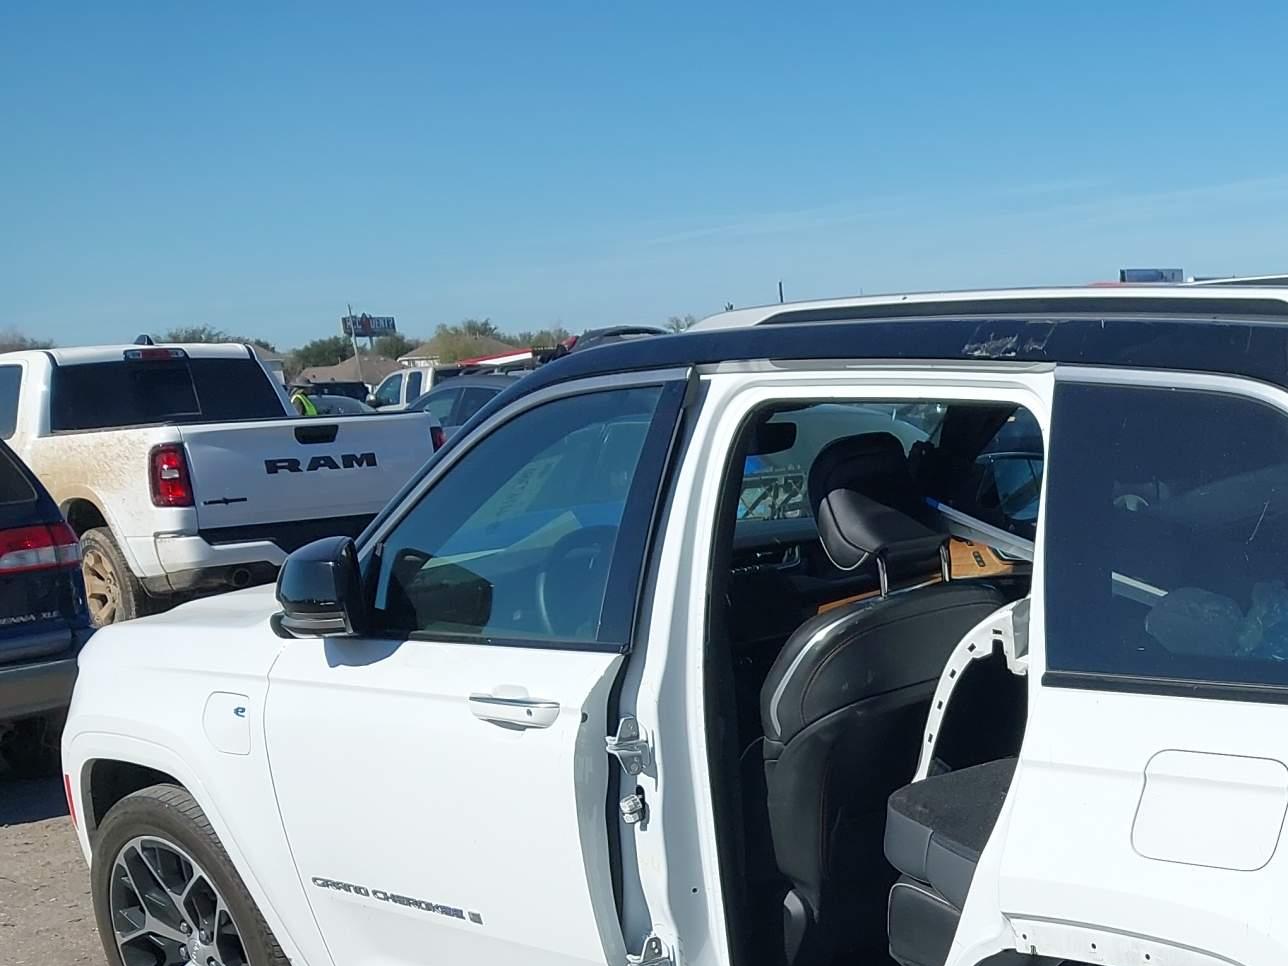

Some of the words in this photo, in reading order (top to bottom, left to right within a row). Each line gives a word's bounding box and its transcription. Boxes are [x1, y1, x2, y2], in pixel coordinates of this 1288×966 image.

[264, 452, 377, 475] RAM
[312, 876, 370, 897] GRAND
[371, 889, 466, 920] CHEROKEE
